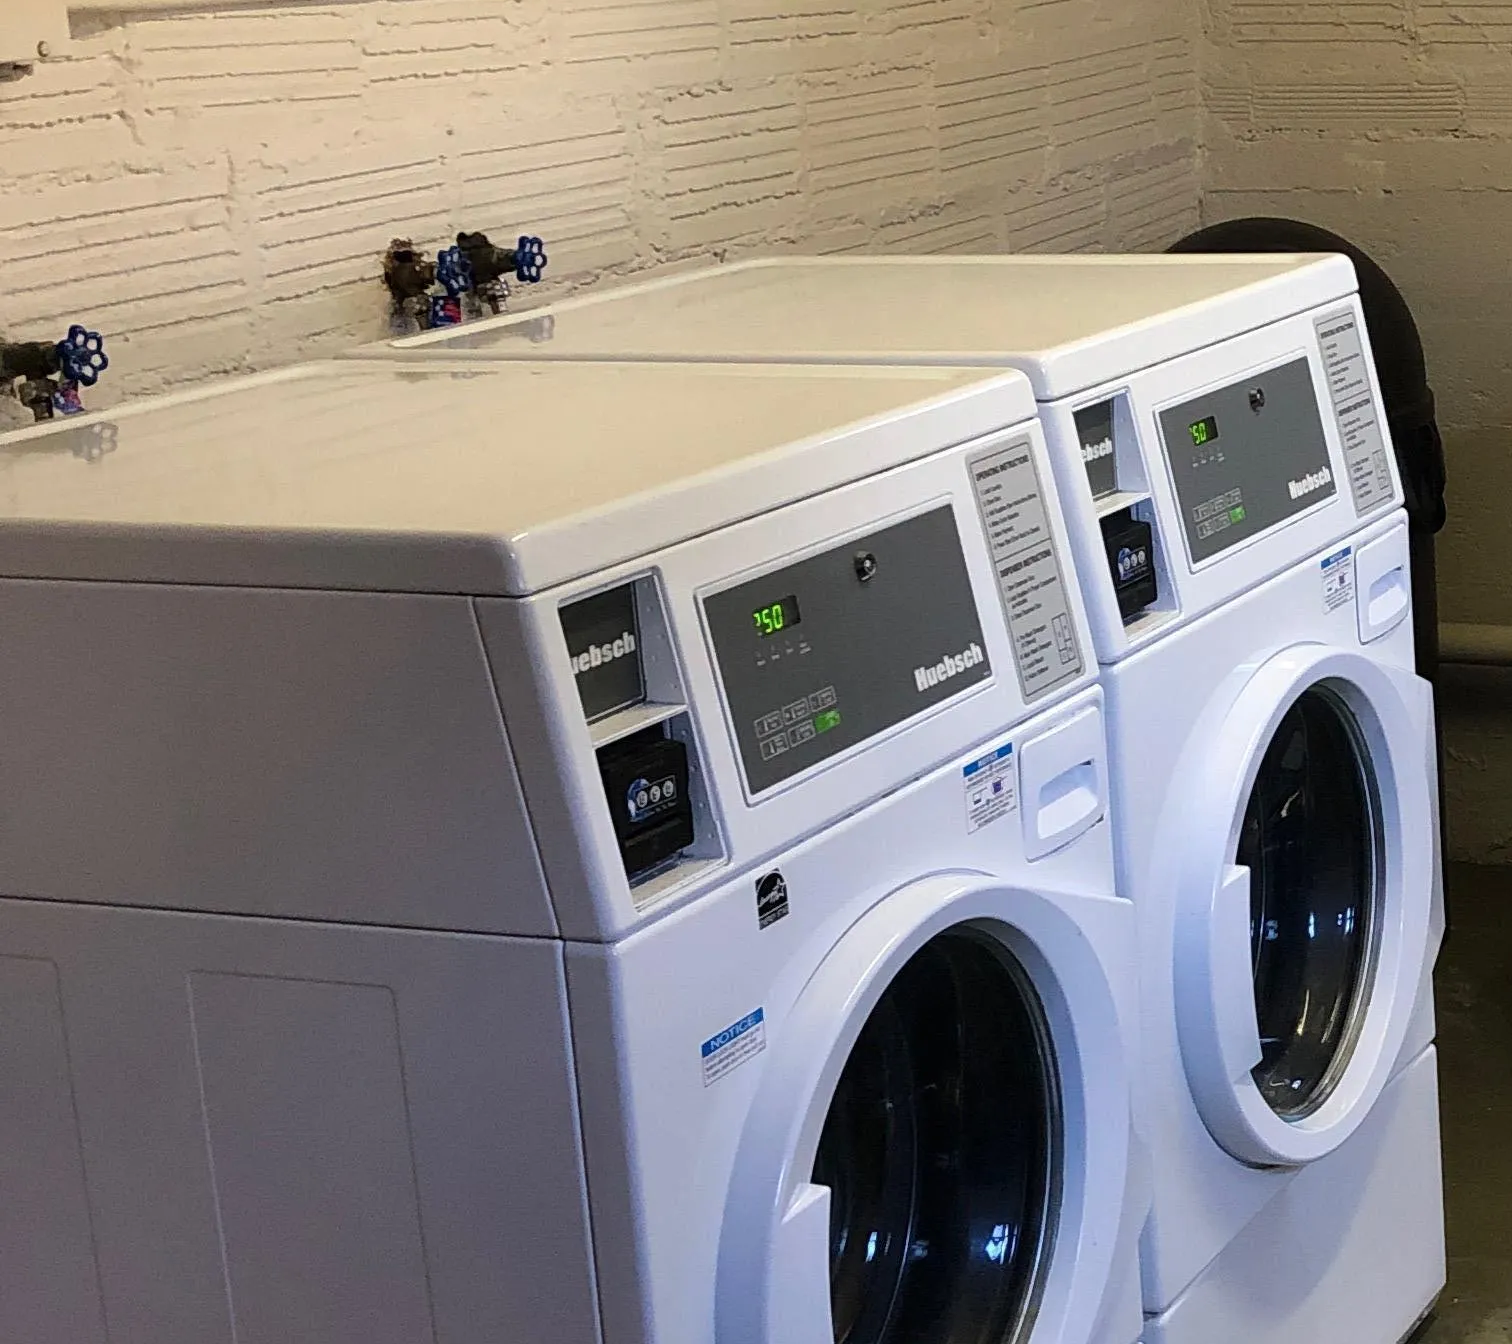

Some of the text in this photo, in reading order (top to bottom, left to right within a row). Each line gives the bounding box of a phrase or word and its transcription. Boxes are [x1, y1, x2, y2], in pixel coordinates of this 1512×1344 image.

[1080, 436, 1113, 463] ebsch
[570, 630, 637, 675] uebsch
[913, 641, 985, 693] Huebsch
[709, 1015, 757, 1052] NOTICE
